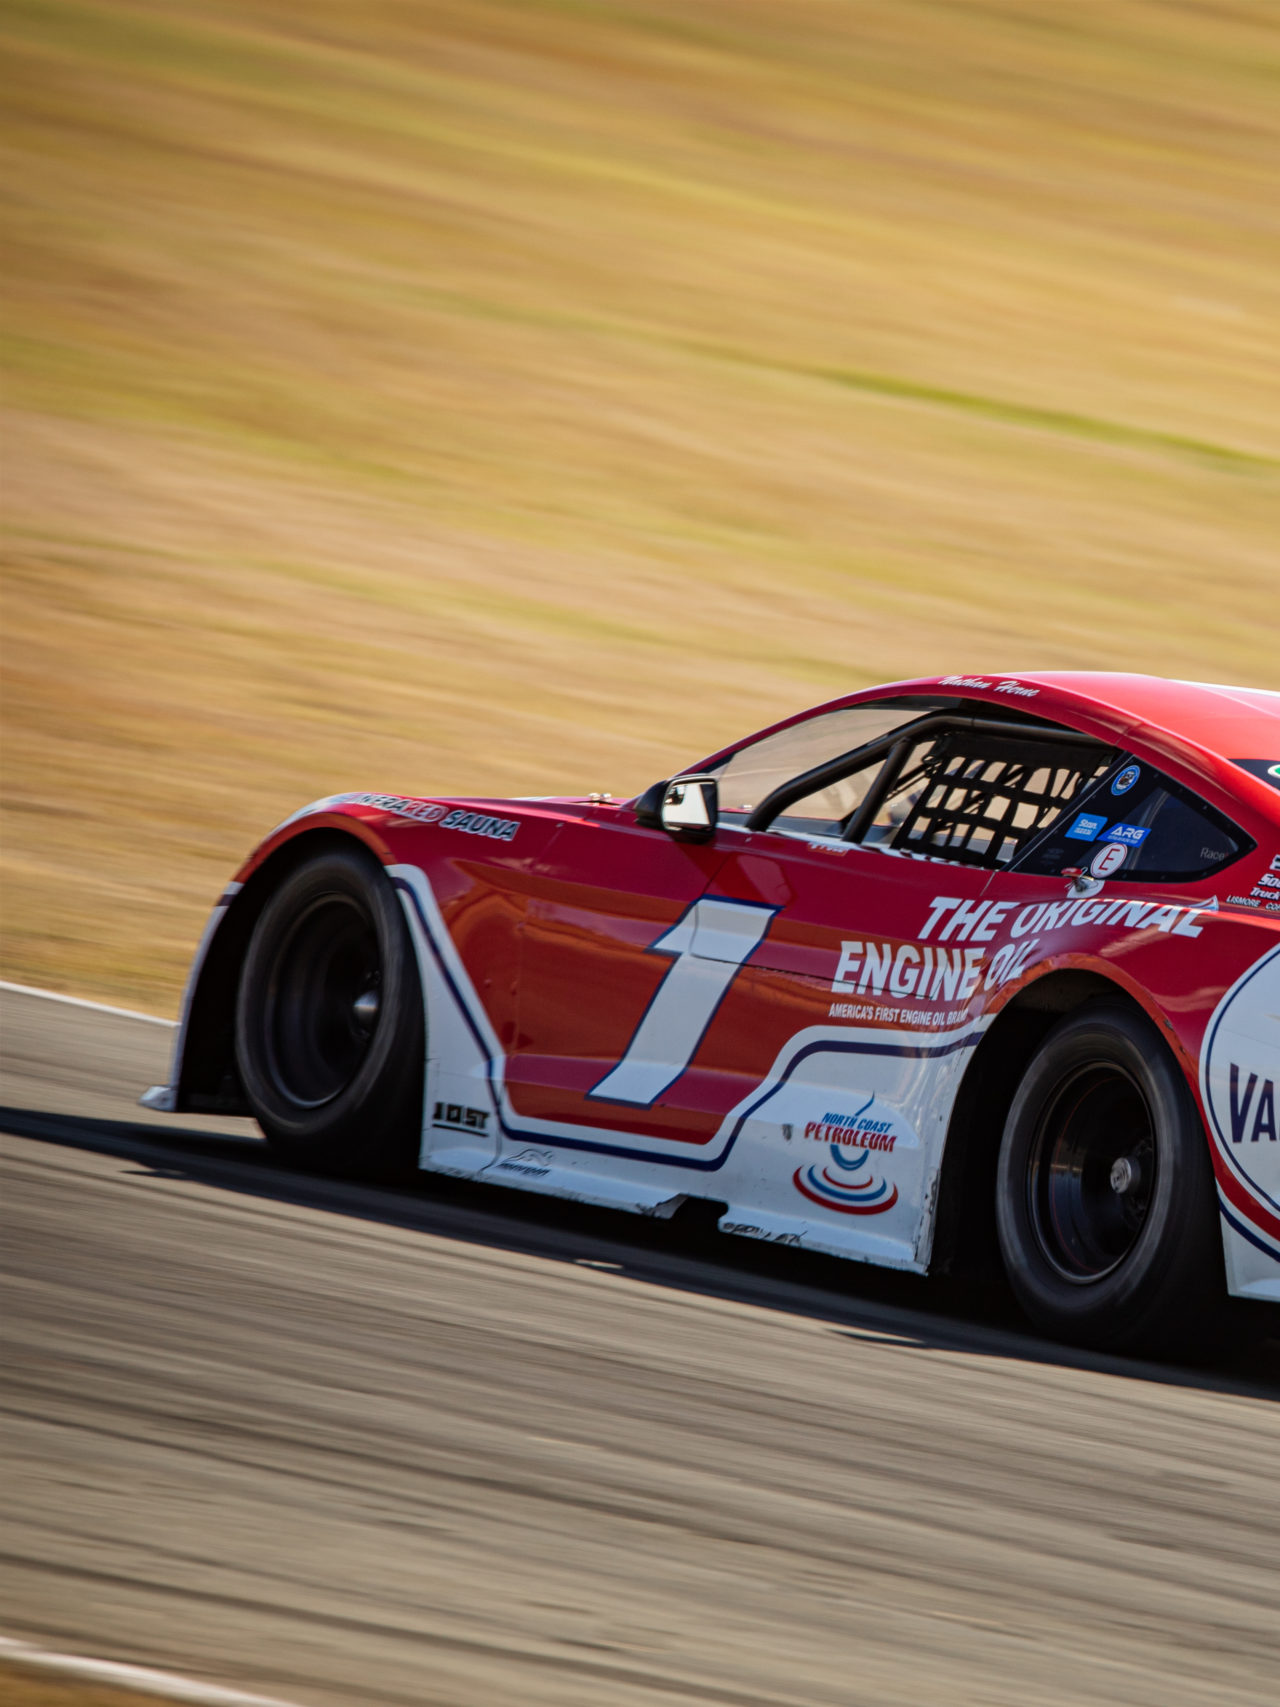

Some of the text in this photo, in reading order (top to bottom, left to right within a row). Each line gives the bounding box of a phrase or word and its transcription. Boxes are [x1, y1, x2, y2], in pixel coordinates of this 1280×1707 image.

[440, 810, 521, 841] SAUNA
[1110, 825, 1145, 840] ARG
[1098, 848, 1121, 871] E
[1226, 895, 1261, 908] LISMORE
[1249, 887, 1280, 901] Truck
[917, 896, 1204, 942] THE ORIGINAL
[831, 938, 1040, 1002] ENGINE OIL
[584, 893, 786, 1110] 1
[828, 1003, 873, 1019] AMERICA'S
[874, 1006, 900, 1022] FIRST
[900, 1009, 931, 1026] ENGINE
[932, 1011, 945, 1026] OIL
[432, 1102, 491, 1129] JOST
[821, 1112, 894, 1133] NORTH COAST
[804, 1121, 898, 1152] PETROLEUM
